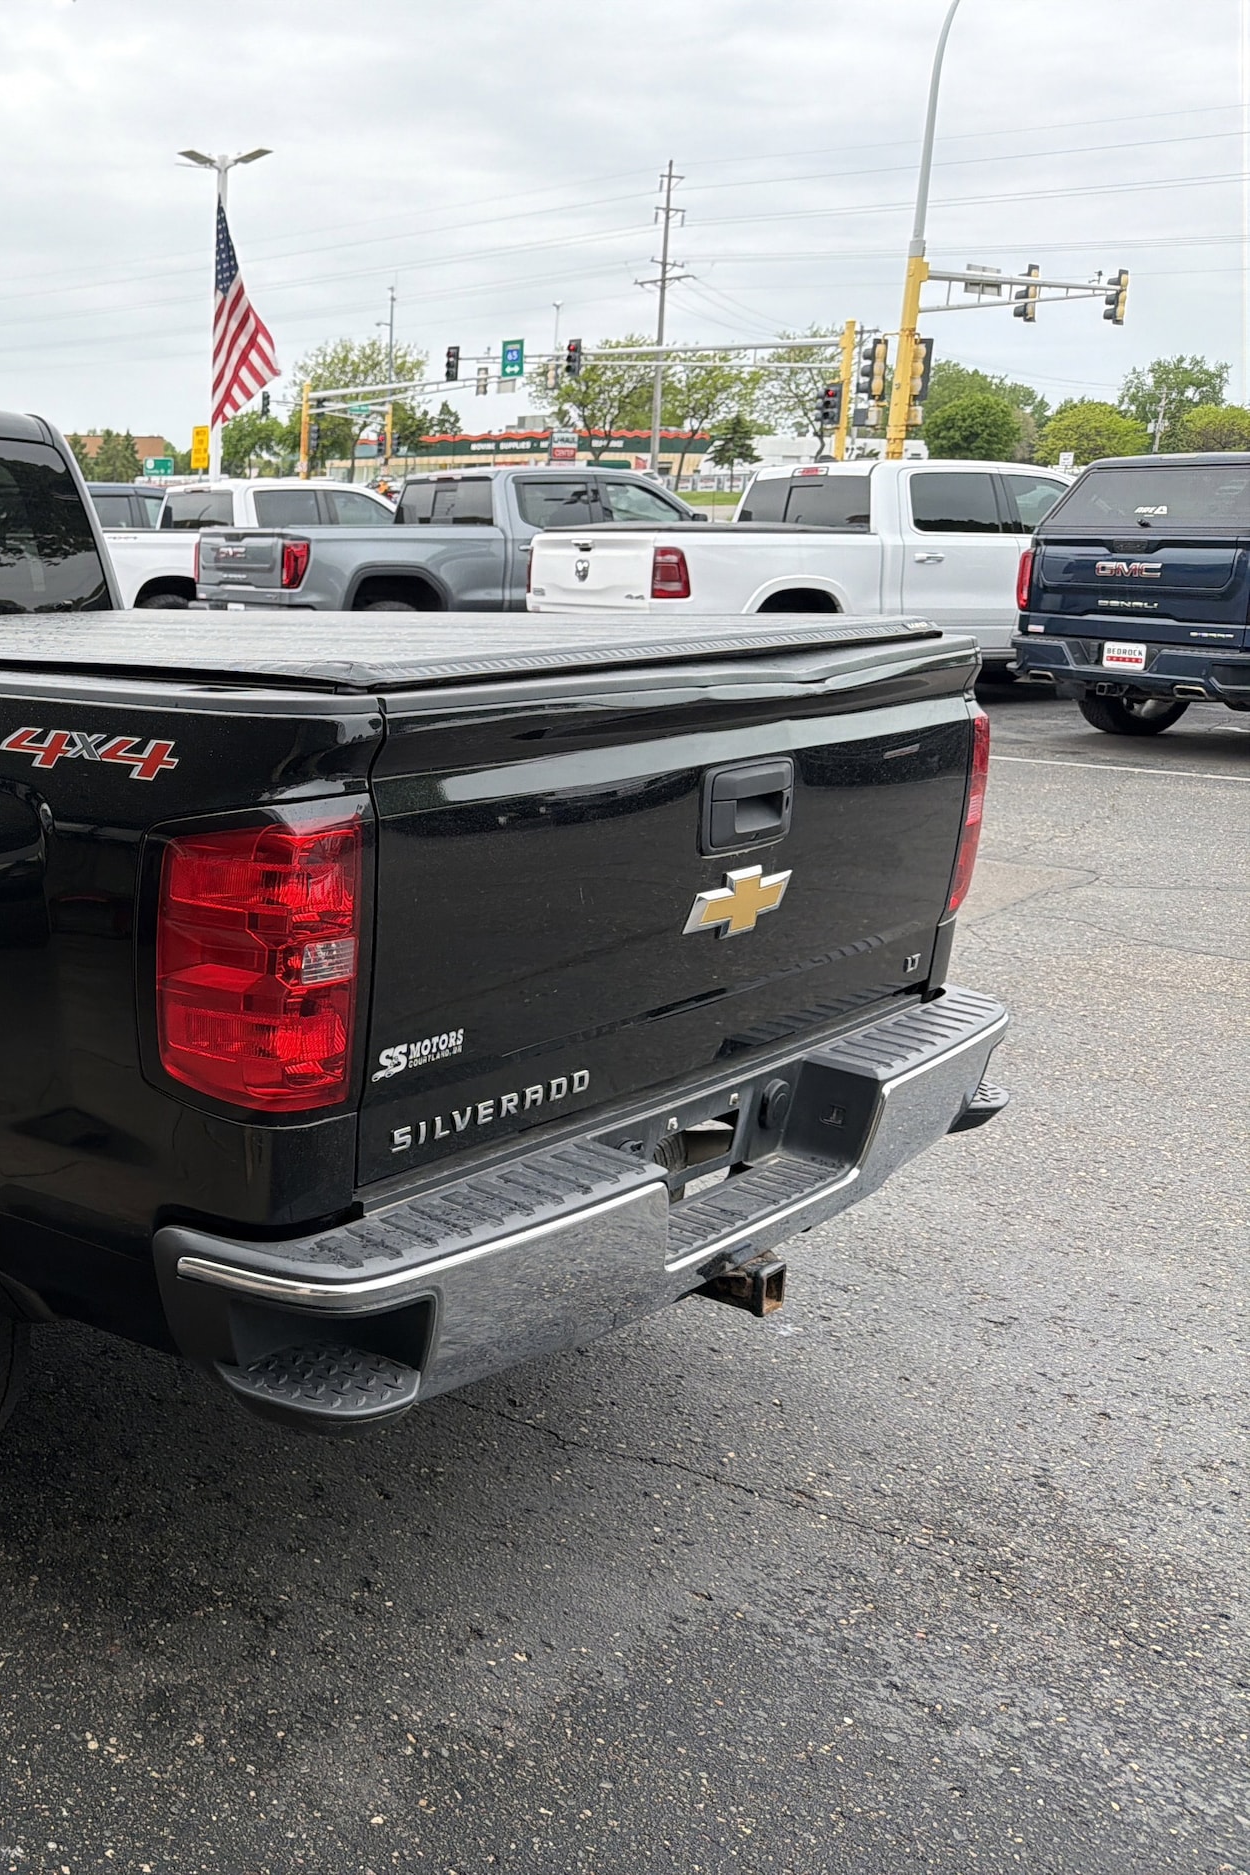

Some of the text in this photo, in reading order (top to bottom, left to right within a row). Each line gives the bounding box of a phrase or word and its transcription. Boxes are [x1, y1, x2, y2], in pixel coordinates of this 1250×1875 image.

[1095, 561, 1163, 578] GMC
[1097, 600, 1159, 609] DENALI
[1106, 647, 1144, 657] BEDROCK
[377, 1027, 465, 1077] SS MOTORS
[390, 1069, 590, 1153] SILVERADO
